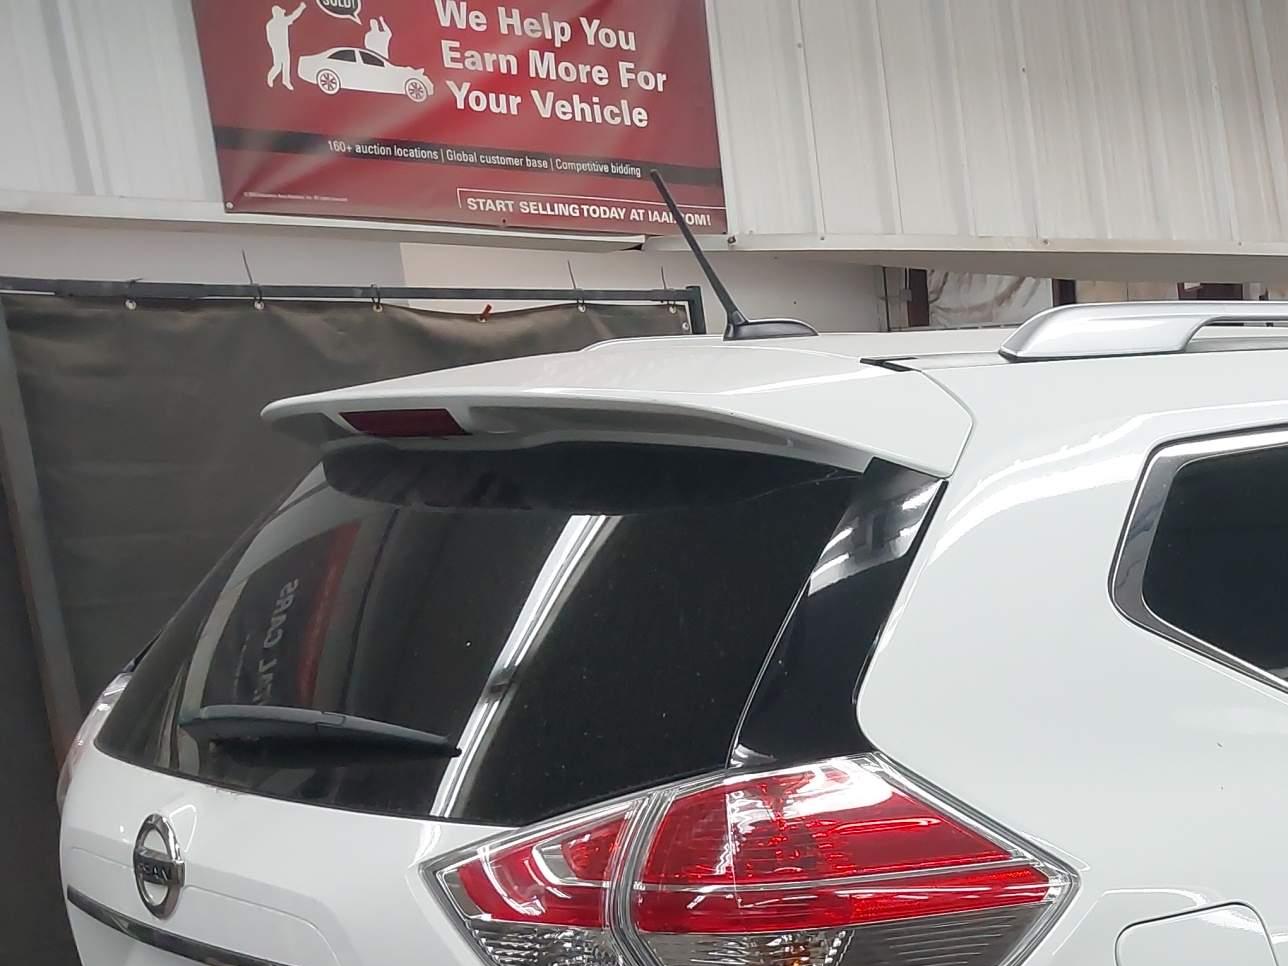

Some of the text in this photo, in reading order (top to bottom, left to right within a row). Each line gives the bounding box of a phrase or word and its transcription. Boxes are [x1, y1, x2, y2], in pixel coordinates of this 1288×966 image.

[434, 0, 637, 51] We Help You
[441, 39, 668, 93] Earn More For
[445, 80, 650, 128] Your Vehicle
[327, 139, 353, 154] 160+
[355, 142, 392, 156] auction
[393, 145, 439, 160] locations
[446, 149, 478, 164] Global
[479, 154, 524, 168] customer
[525, 155, 548, 169] base
[555, 158, 609, 174] Competitive
[611, 163, 642, 178] bidding
[466, 197, 712, 226] START SELLING TODAY AT IAAI.OM!
